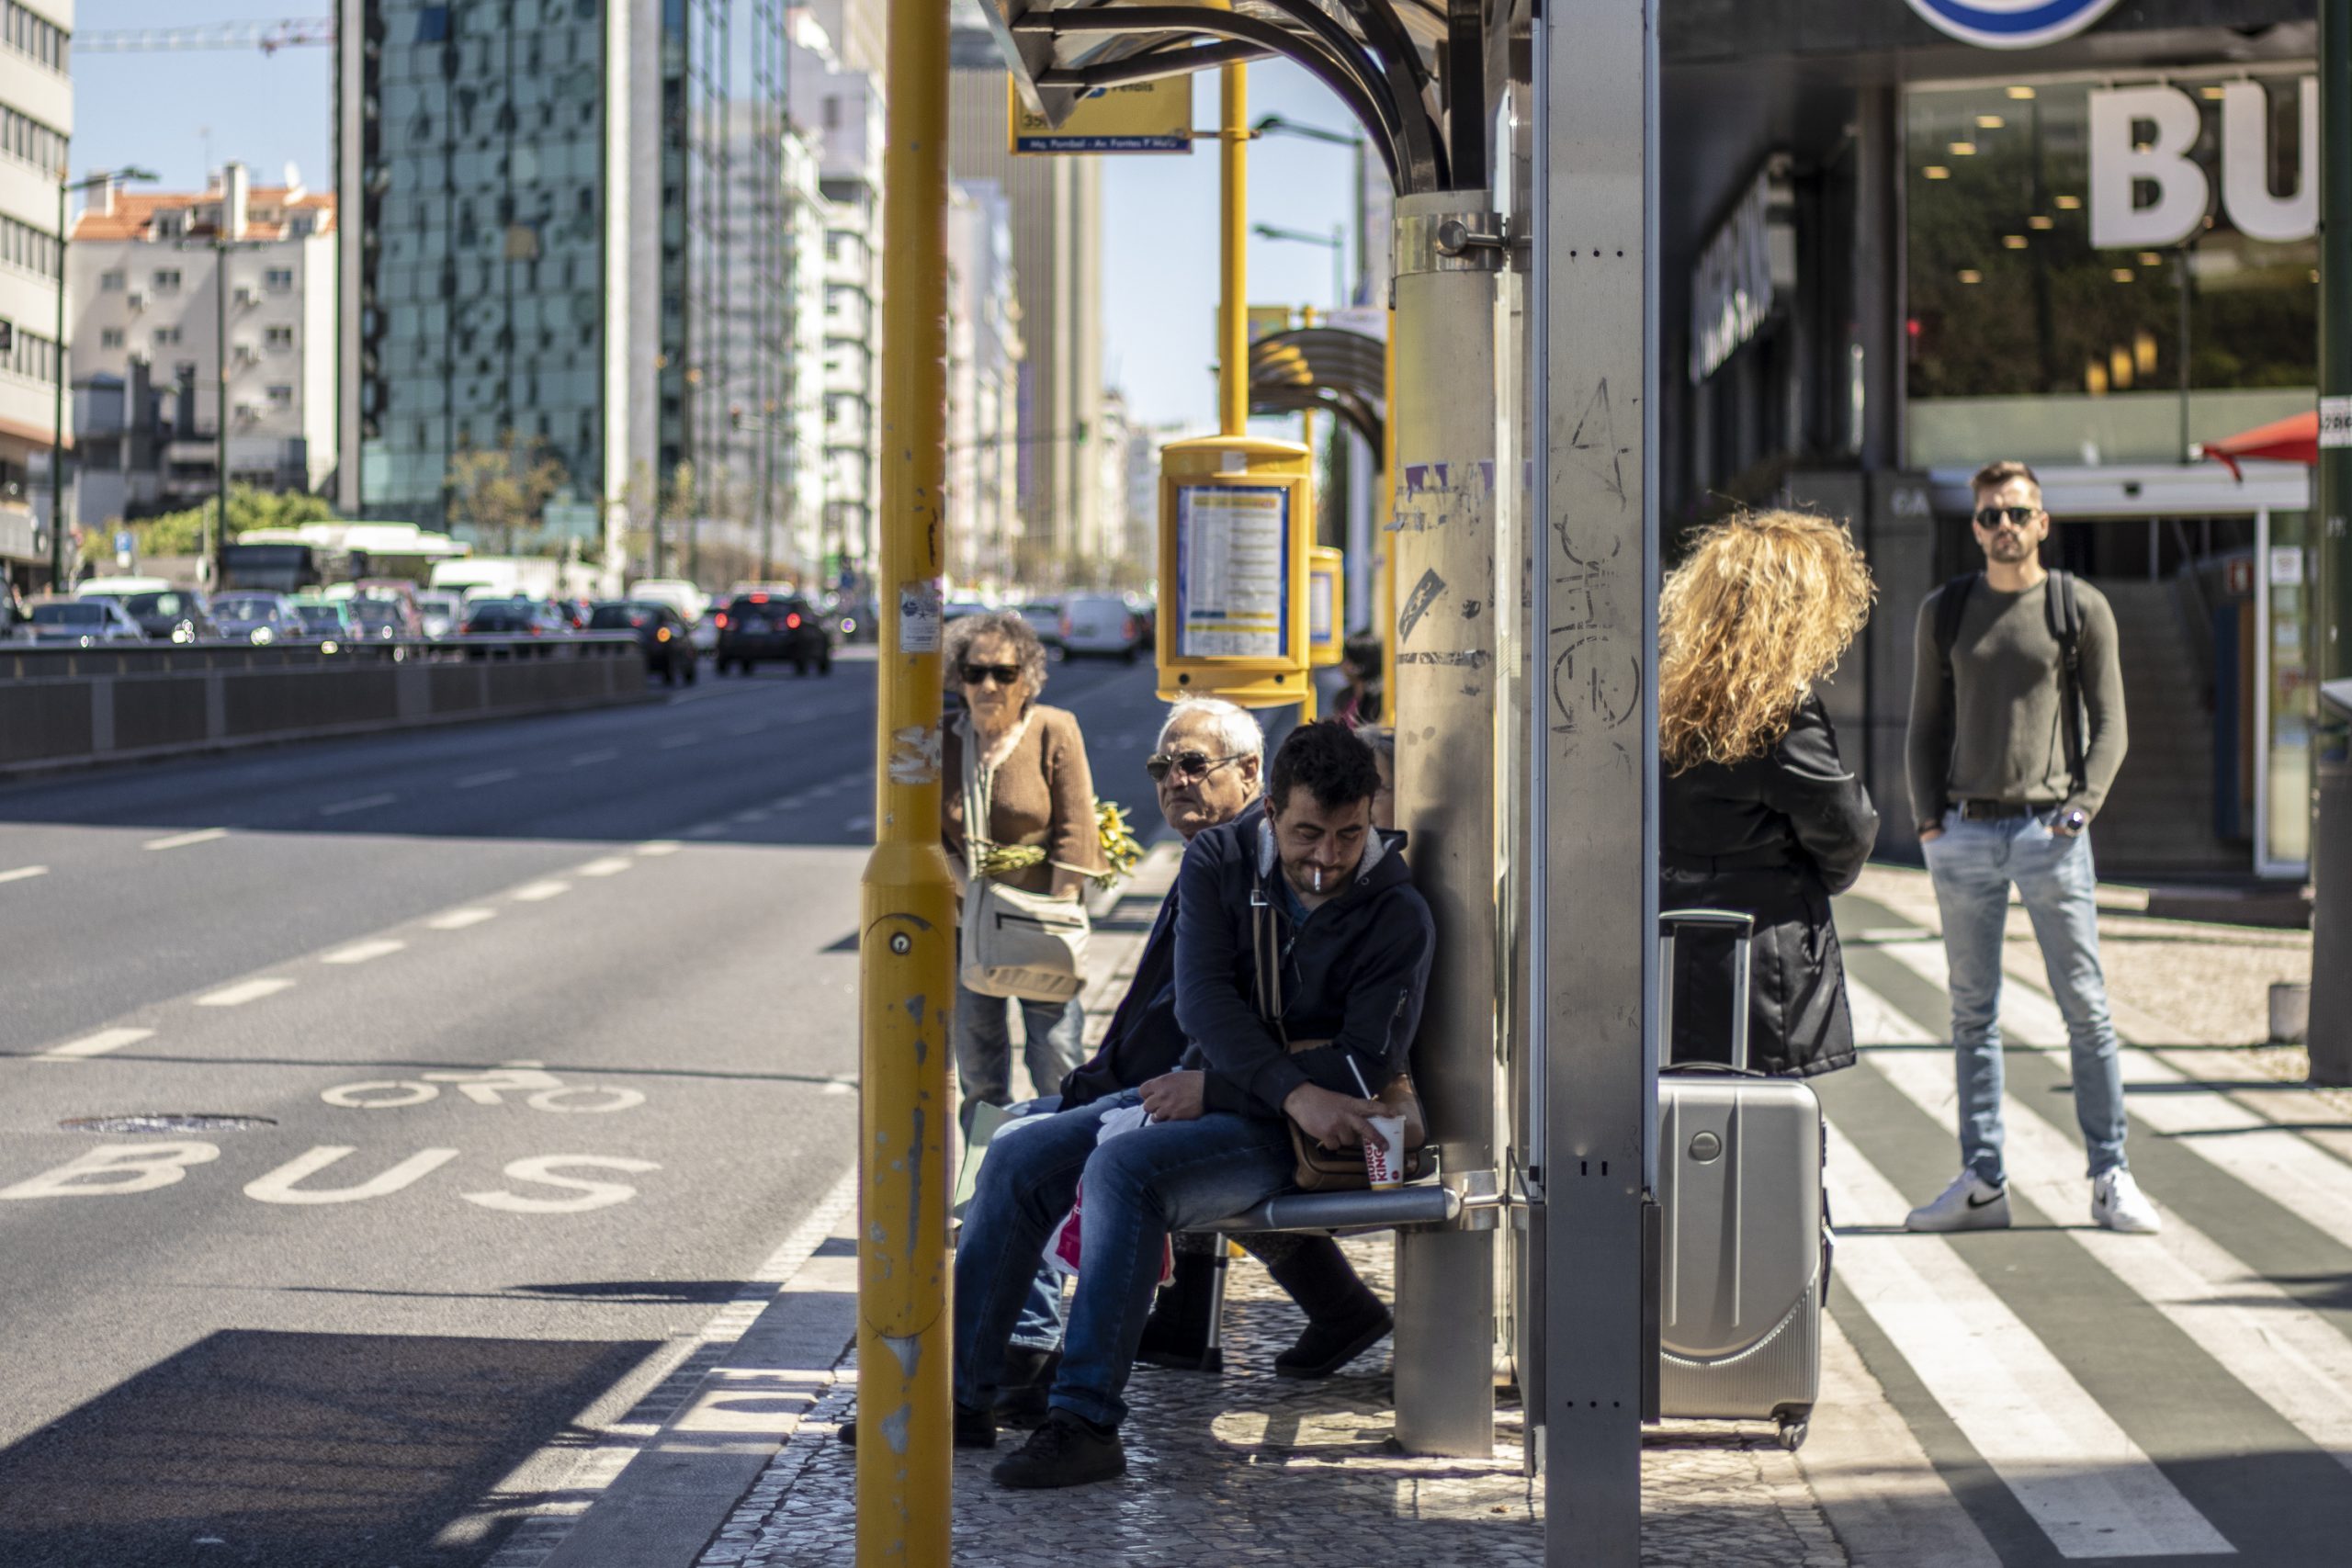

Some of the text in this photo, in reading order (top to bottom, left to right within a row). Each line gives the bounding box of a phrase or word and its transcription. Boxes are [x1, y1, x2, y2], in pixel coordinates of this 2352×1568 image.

[2088, 75, 2320, 250] BU
[0, 1141, 663, 1213] BUS
[1374, 1147, 1388, 1182] KING
